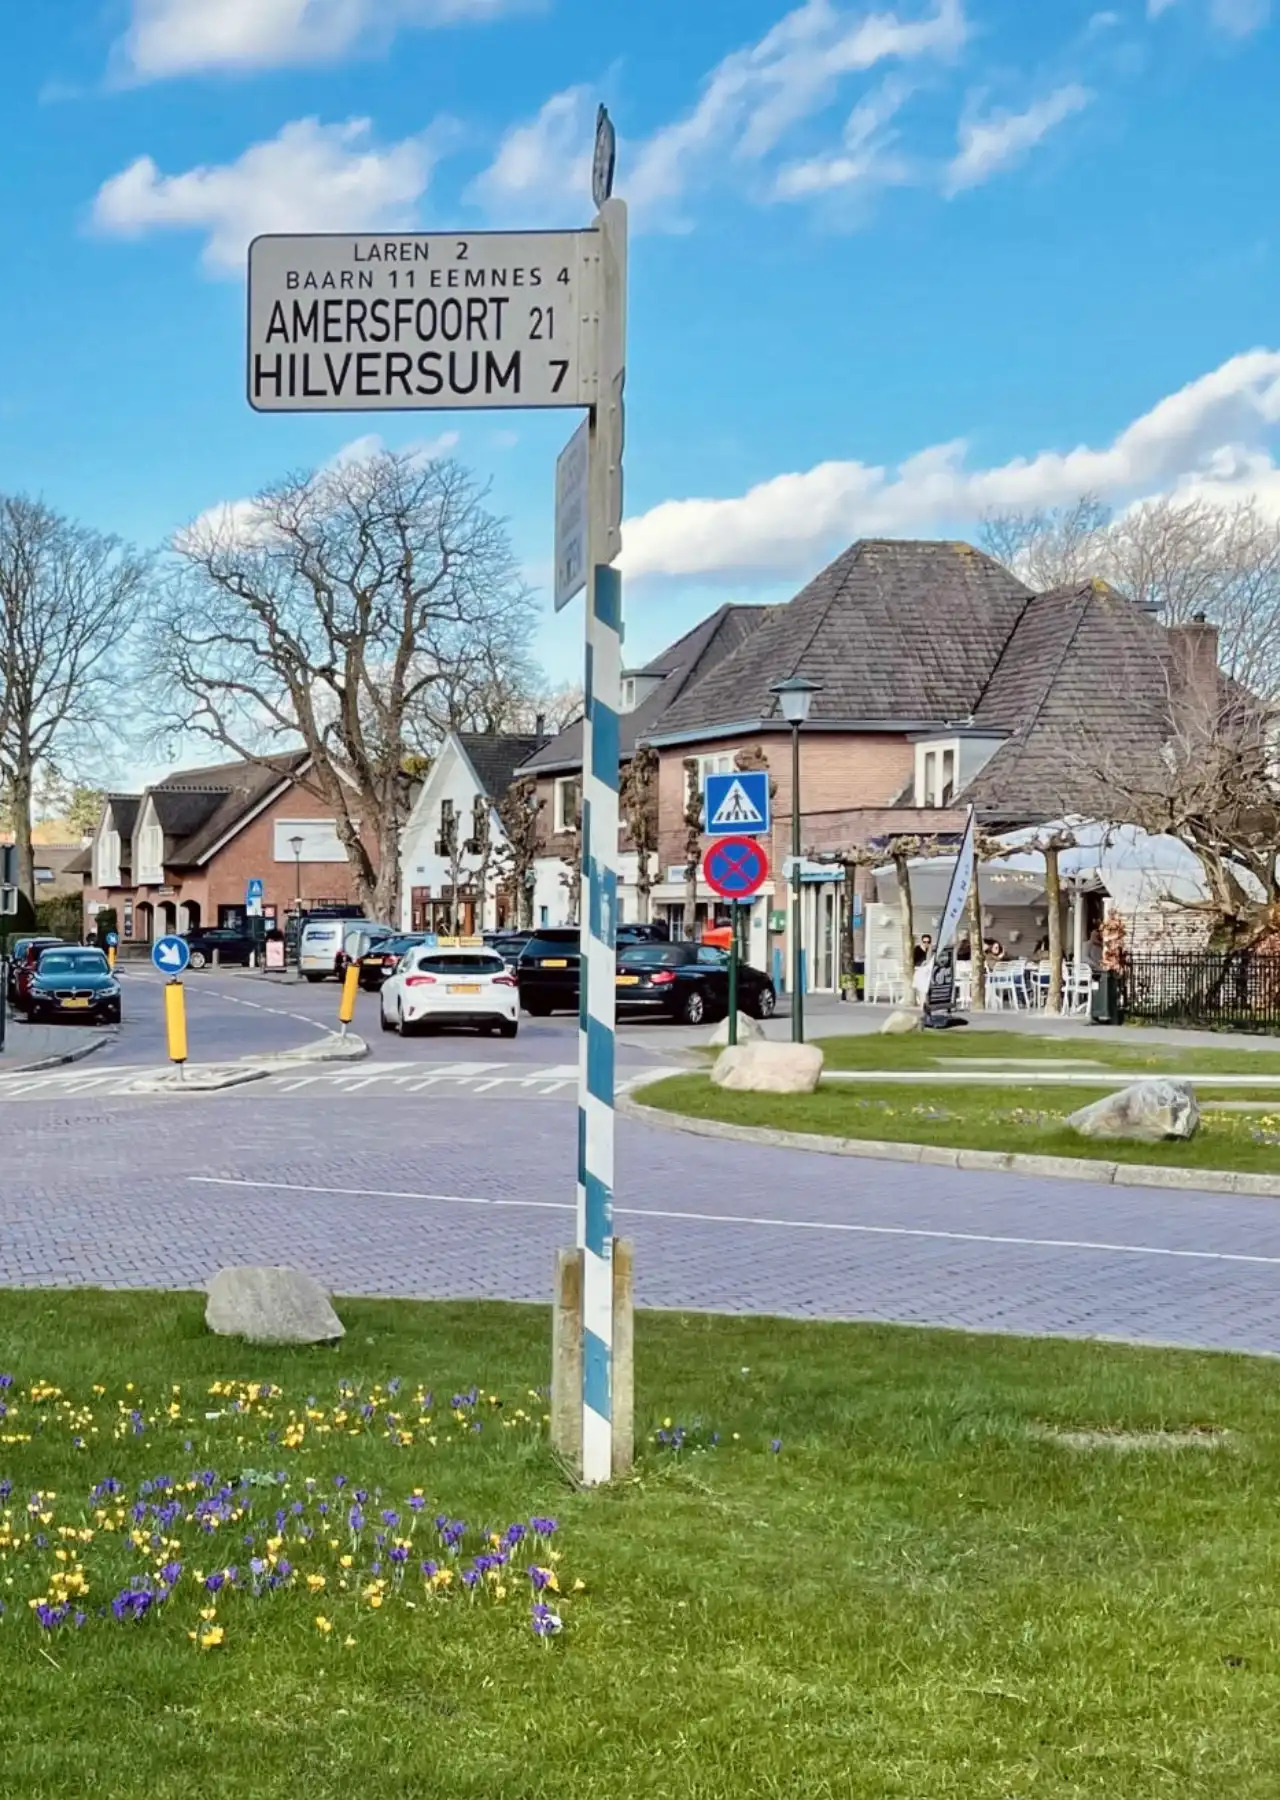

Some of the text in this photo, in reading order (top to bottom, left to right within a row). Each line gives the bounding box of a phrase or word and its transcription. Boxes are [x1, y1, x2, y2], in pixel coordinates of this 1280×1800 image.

[354, 241, 468, 262] LAREN 2
[286, 267, 570, 290] BAARN 11 EEMNES 4
[265, 296, 554, 344] AMERSFOORT 21
[254, 350, 570, 397] HILVERSUM 7
